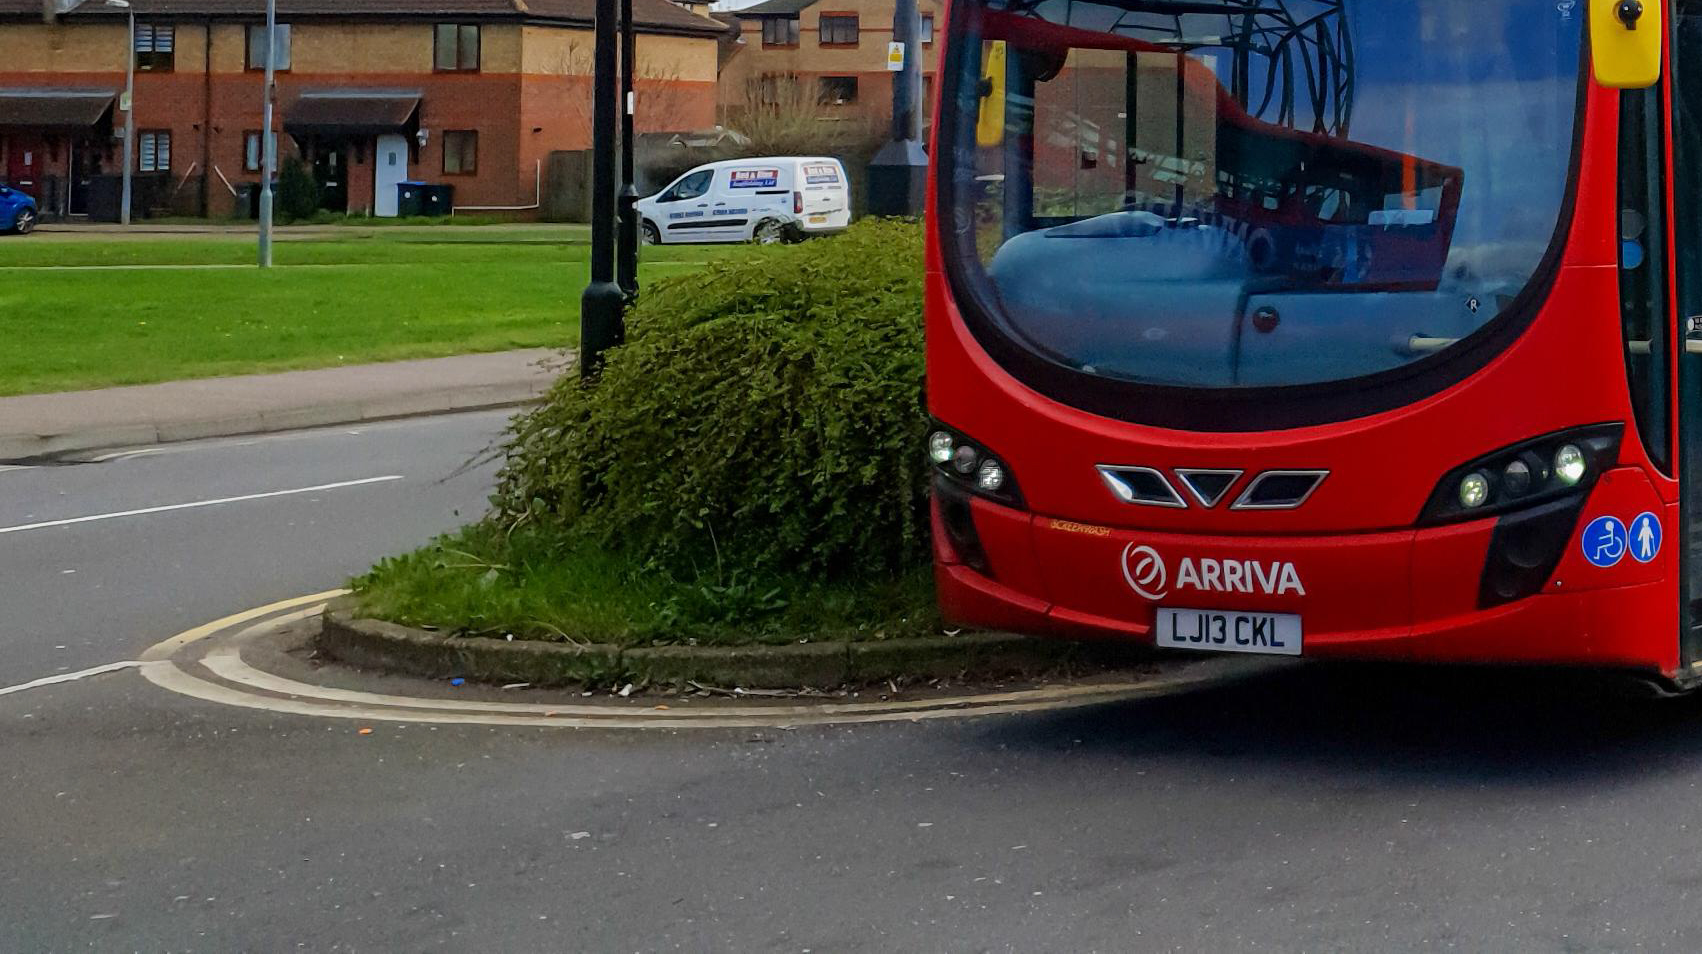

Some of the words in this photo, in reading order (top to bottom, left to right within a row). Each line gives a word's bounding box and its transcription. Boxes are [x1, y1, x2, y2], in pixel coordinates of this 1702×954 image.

[1176, 557, 1306, 596] ARRIVA
[1172, 613, 1226, 644] LJ13
[1235, 616, 1284, 647] CKL
